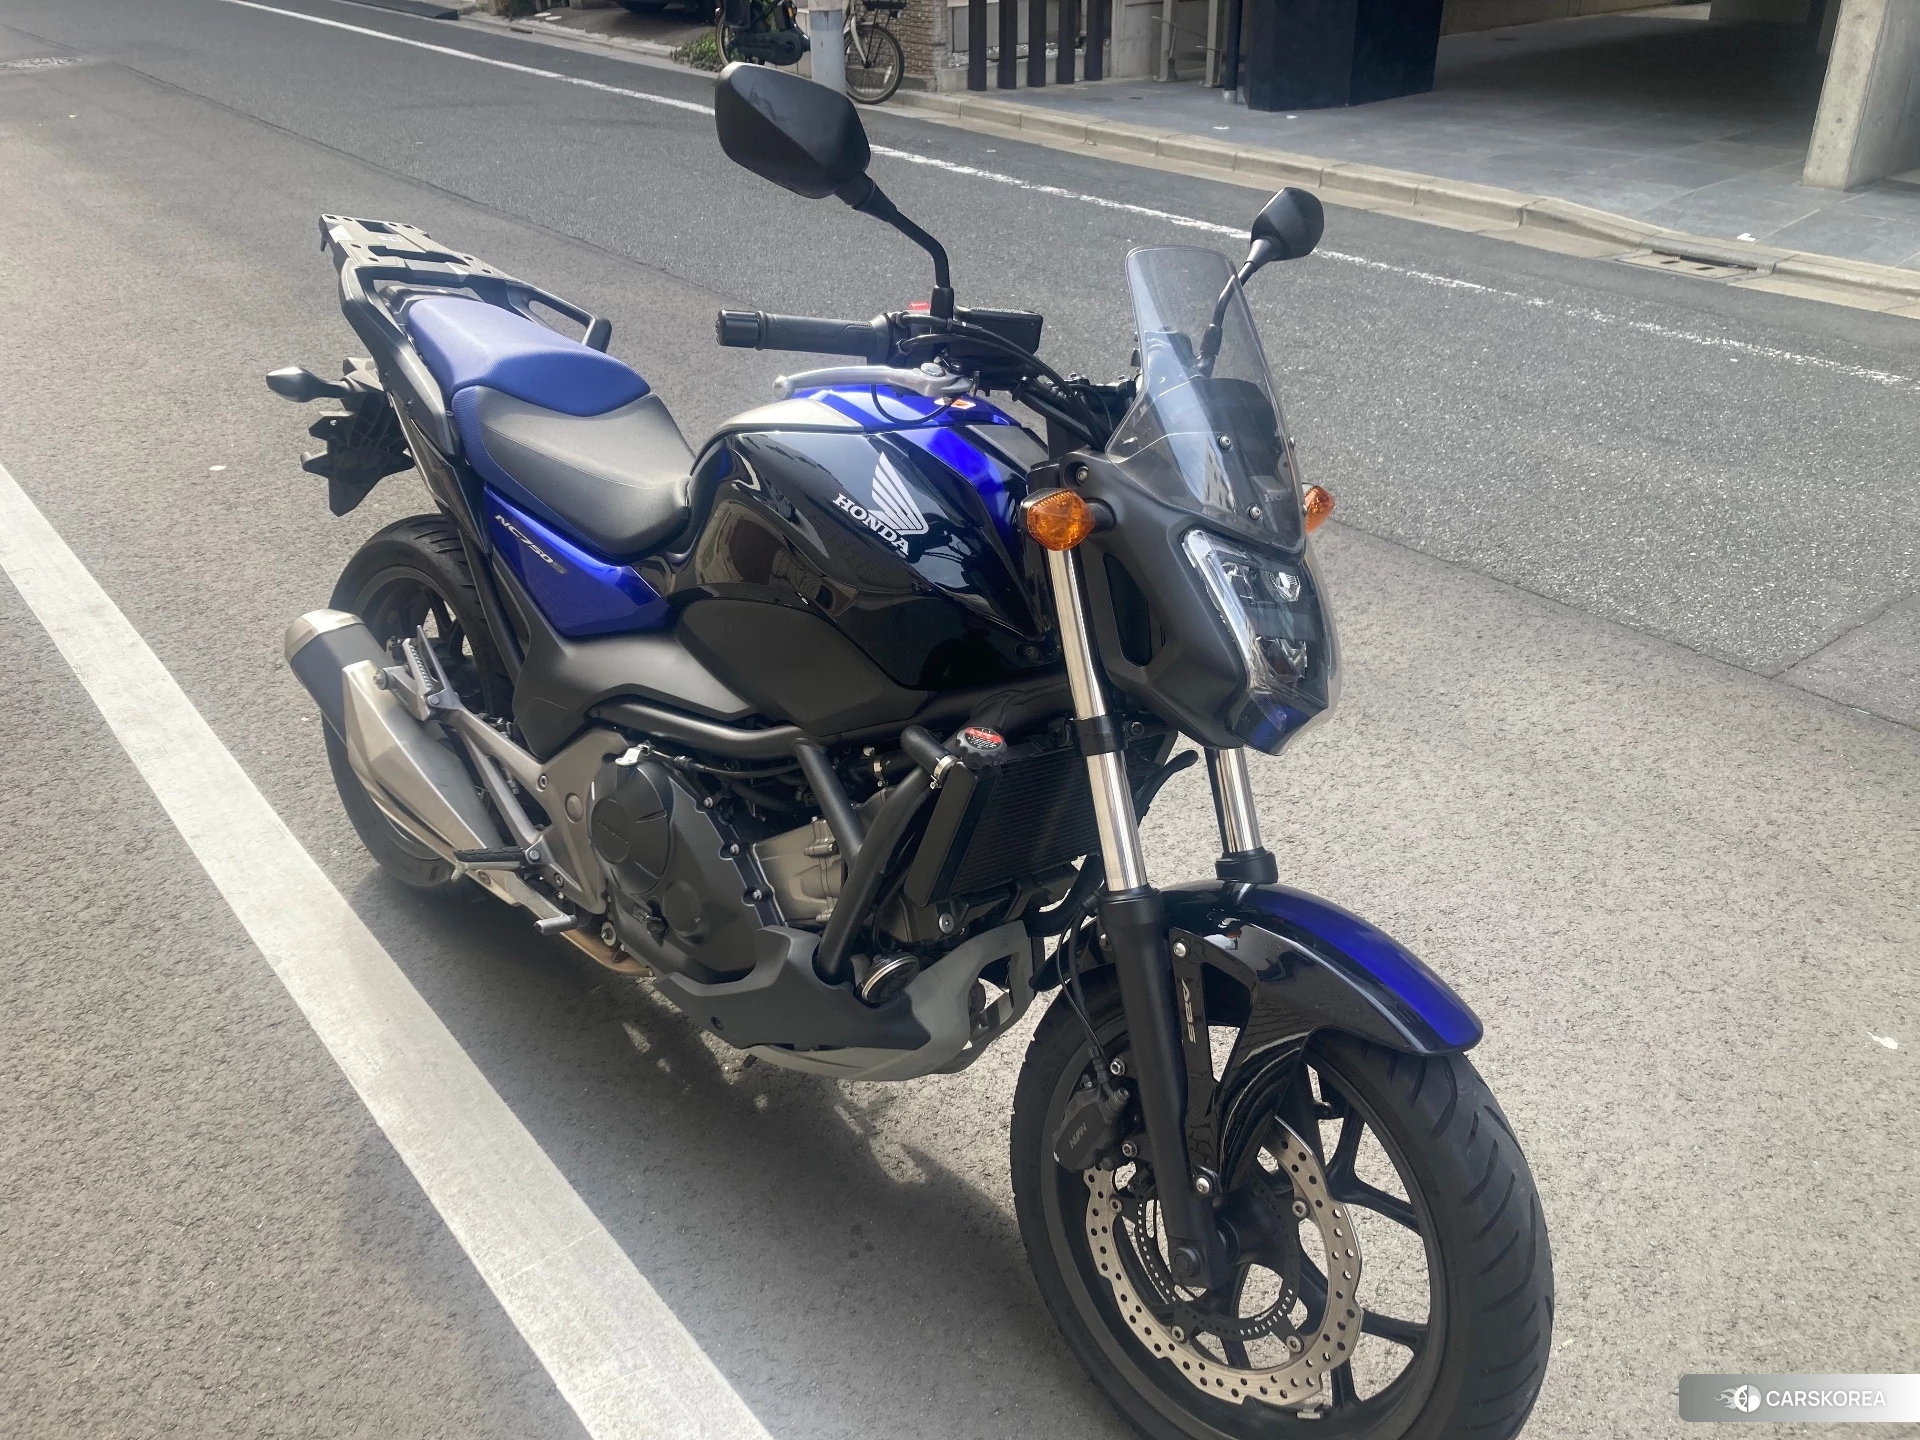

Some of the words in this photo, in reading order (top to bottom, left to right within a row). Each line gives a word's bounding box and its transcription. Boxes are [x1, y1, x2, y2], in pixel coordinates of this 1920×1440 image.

[494, 514, 568, 574] NC750S
[832, 493, 909, 555] HONDA
[1181, 978, 1197, 1044] ABS
